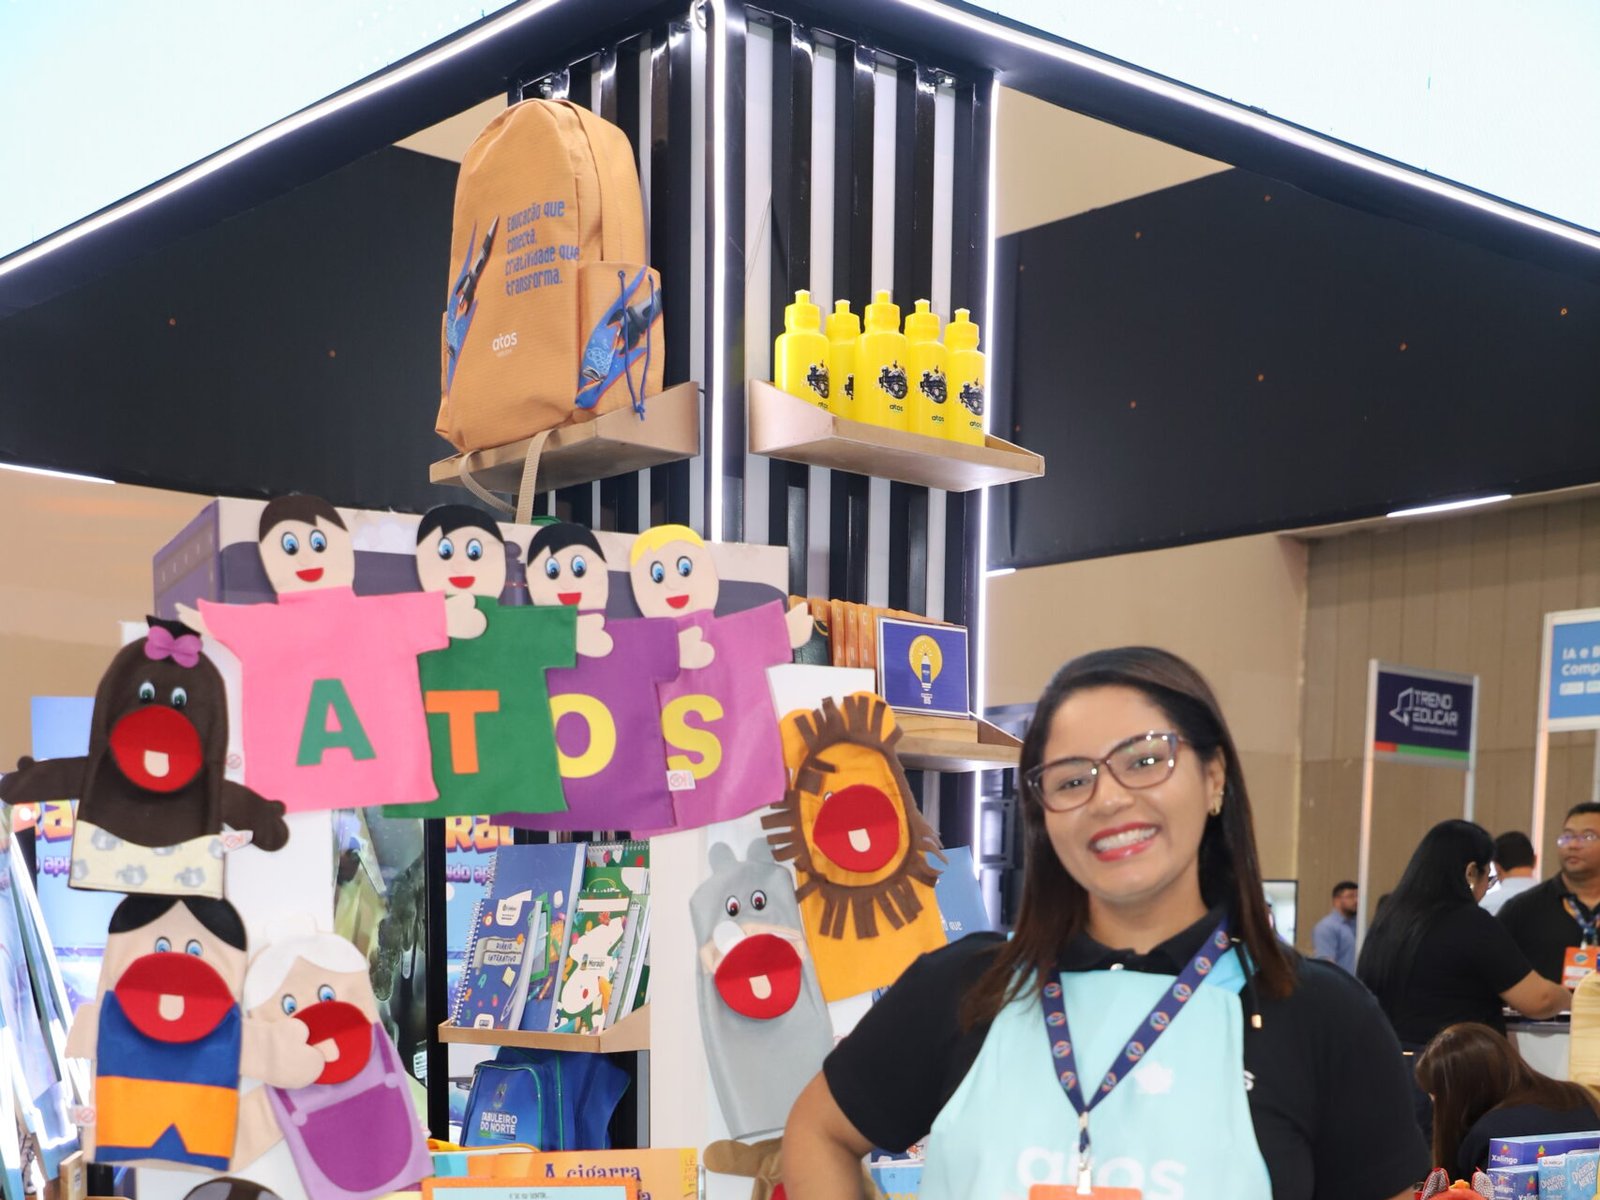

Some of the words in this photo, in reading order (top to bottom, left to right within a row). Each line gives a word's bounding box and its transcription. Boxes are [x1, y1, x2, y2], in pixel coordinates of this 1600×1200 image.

[543, 200, 566, 217] que
[559, 244, 580, 261] que
[492, 332, 518, 351] atos
[889, 404, 904, 412] atos
[1414, 690, 1453, 710] TREND
[1412, 707, 1459, 727] EDUCAR
[480, 1121, 490, 1131] DO
[490, 1122, 516, 1134] NORTE
[1491, 1154, 1518, 1165] Xalingo
[545, 1163, 555, 1178] A
[567, 1164, 641, 1181] cigarra
